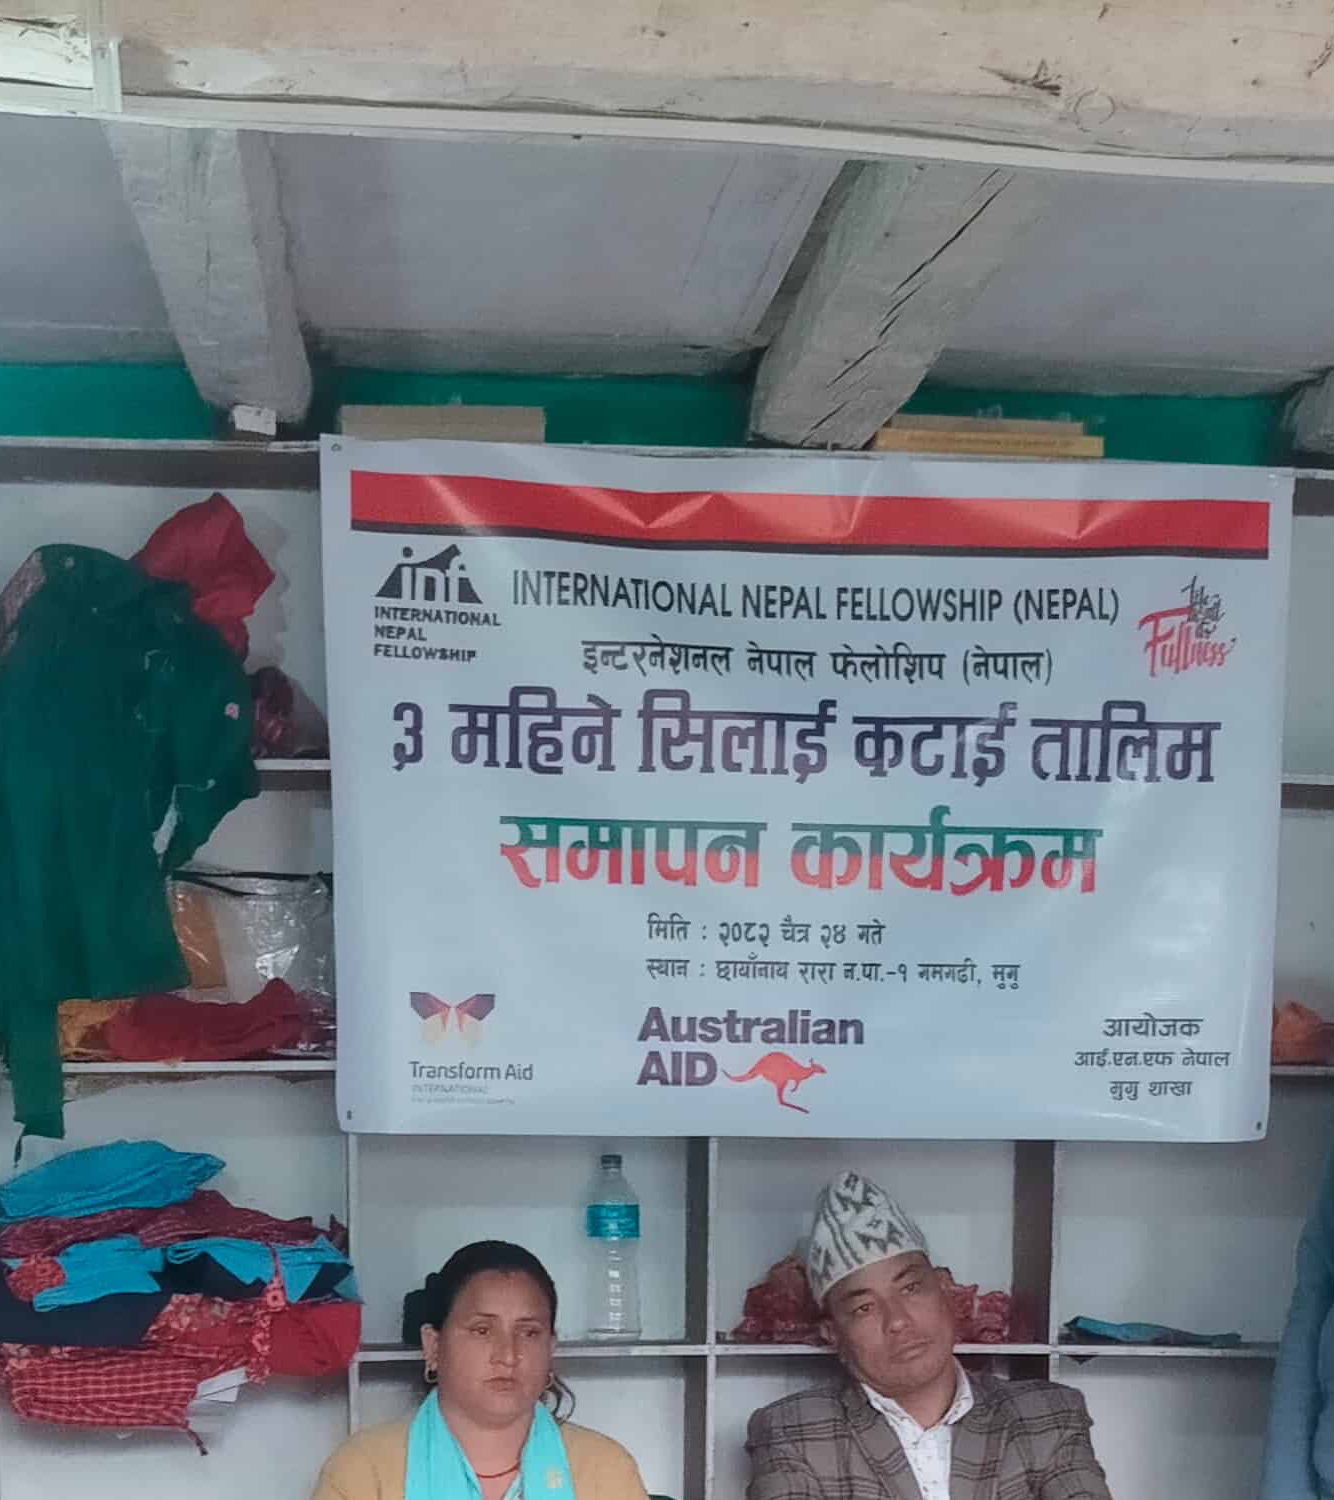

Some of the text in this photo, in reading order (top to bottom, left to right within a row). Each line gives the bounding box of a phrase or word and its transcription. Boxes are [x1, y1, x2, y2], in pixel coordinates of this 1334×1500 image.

[513, 570, 1120, 626] INTERNATIONAL NEPAL FELLOWSHIP (NEPAL)
[373, 605, 502, 629] INTERNATIONAL
[374, 624, 428, 642] NEPAL
[373, 642, 477, 663] FELLOWSHIP
[581, 632, 1053, 686] इन्टरनेशनल नेपाल फेलोशिप (नेपाल)
[391, 685, 1222, 788] ३ महिने सिलाई कटाई तालिम
[499, 804, 1104, 897] समापन कार्यक्रम
[646, 911, 692, 941] मिति
[718, 921, 770, 948] २०८२
[779, 914, 812, 943] चैत्र
[820, 924, 847, 950] २४
[856, 918, 887, 945] गते
[645, 958, 691, 980] स्थान
[797, 961, 838, 985] रारा
[636, 1006, 865, 1046] Australian
[1102, 1011, 1204, 1038] आयोजक
[408, 1060, 534, 1081] Transform Aid
[635, 1050, 718, 1087] AID
[1074, 1047, 1232, 1068] आई.एन.एफ नेपाल
[1109, 1080, 1194, 1102] मुगु शाखा
